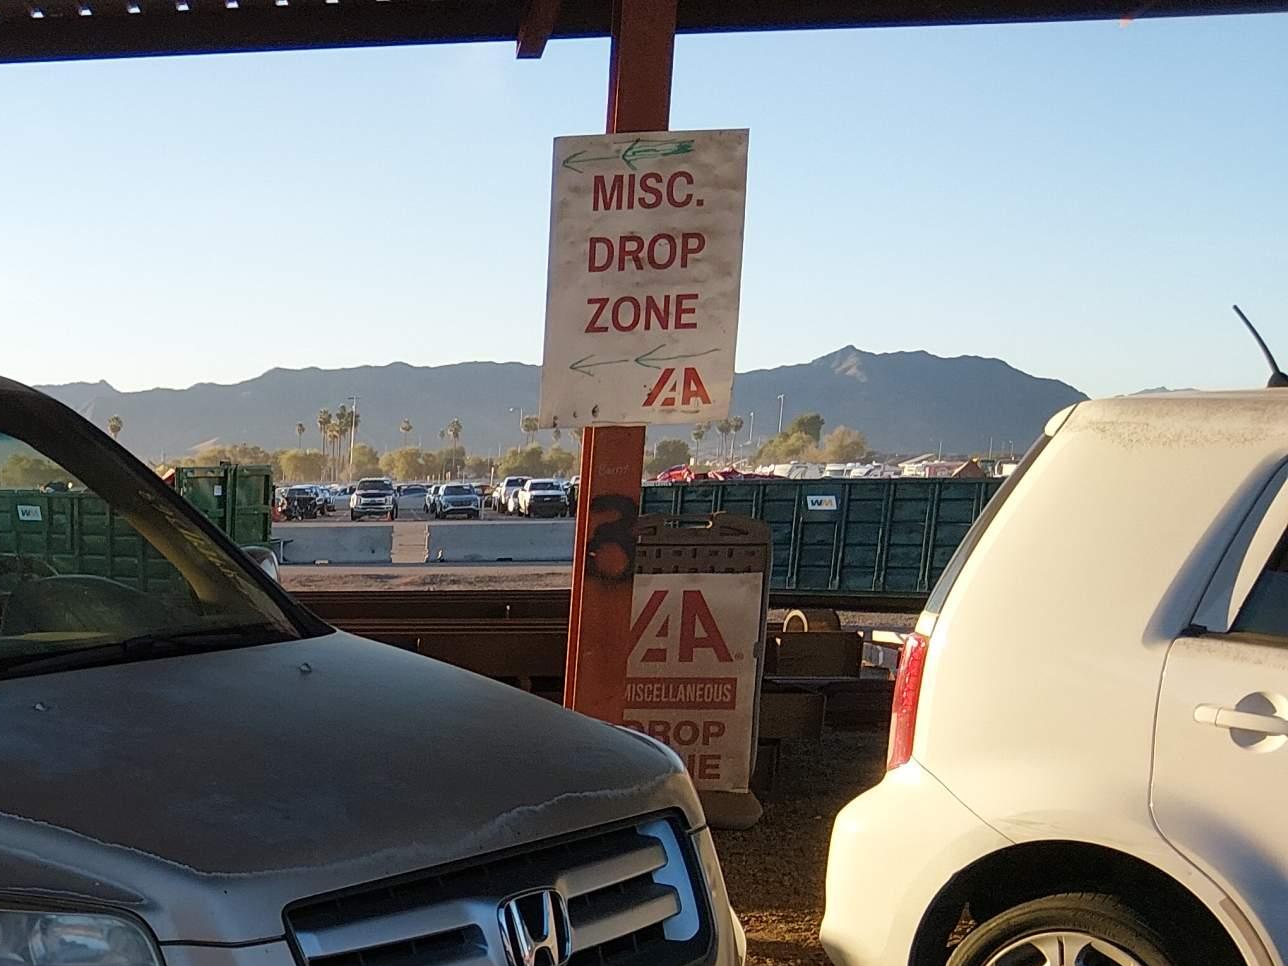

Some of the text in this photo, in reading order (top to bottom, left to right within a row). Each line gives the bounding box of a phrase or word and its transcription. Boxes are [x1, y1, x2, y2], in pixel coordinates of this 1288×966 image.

[592, 170, 704, 211] MISC.
[587, 232, 706, 273] DROP
[584, 293, 699, 333] ZONE
